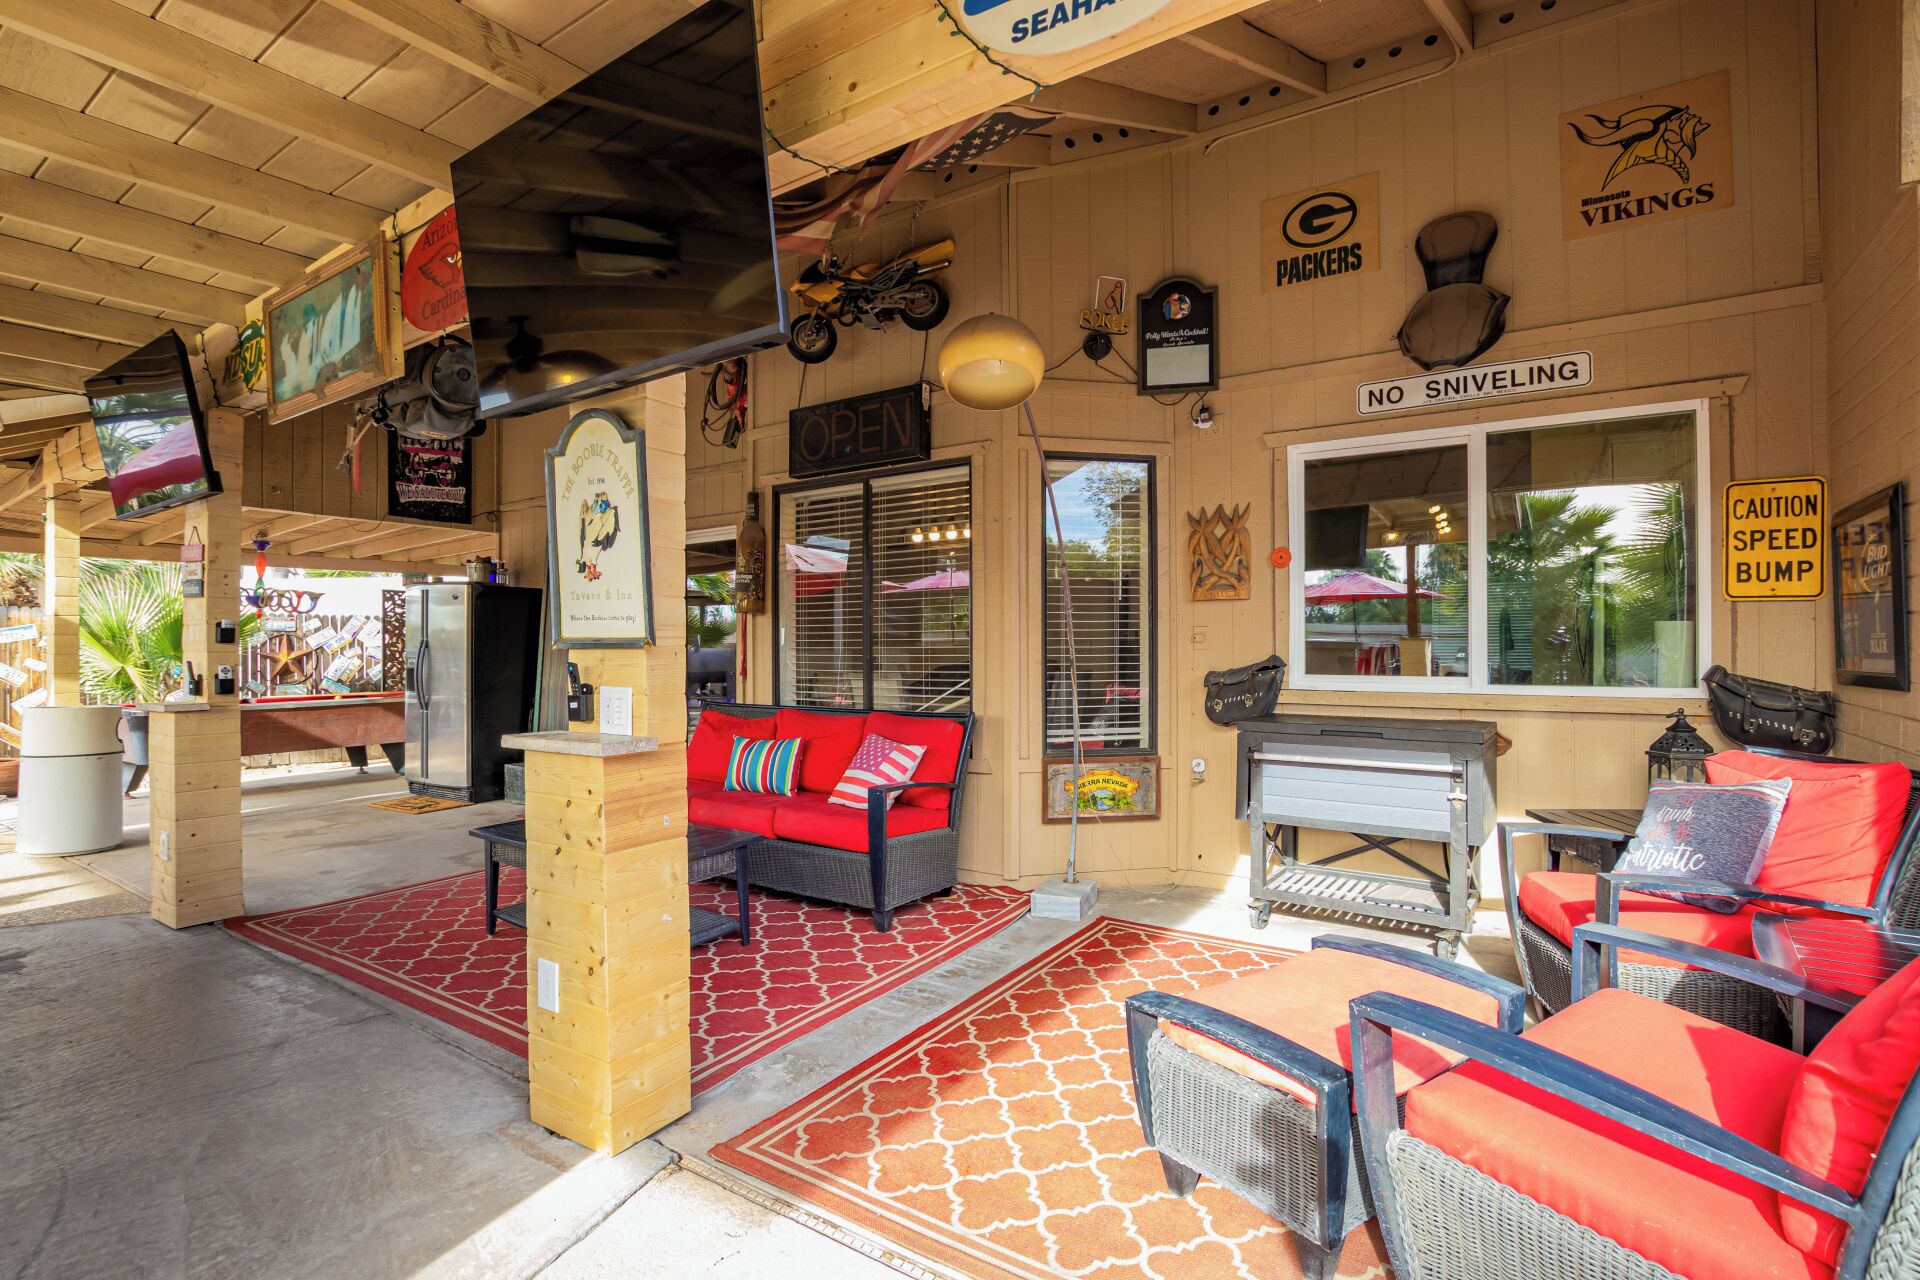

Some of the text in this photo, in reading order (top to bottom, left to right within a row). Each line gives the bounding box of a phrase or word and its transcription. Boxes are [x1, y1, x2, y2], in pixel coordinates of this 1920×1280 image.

[1579, 183, 1715, 227] VIKINGS
[1581, 190, 1631, 207] Minnesota
[1276, 242, 1363, 287] PACKERS
[1144, 331, 1161, 342] Polly
[1368, 361, 1579, 407] NO SNIVELING
[801, 398, 911, 461] OPEN
[562, 476, 575, 501] THE
[571, 443, 605, 475] BOOBIE
[399, 483, 465, 502] WE SALUTE YOU
[1733, 495, 1818, 520] CAUTION
[1733, 528, 1817, 551] SPEED
[1867, 545, 1888, 563] BUD
[1737, 561, 1814, 583] BUMP
[1863, 561, 1890, 581] LIGHT
[570, 588, 633, 600] Tavern & Inn
[1078, 778, 1128, 790] IERRA NEVADA
[1622, 840, 1706, 872] patriotic
